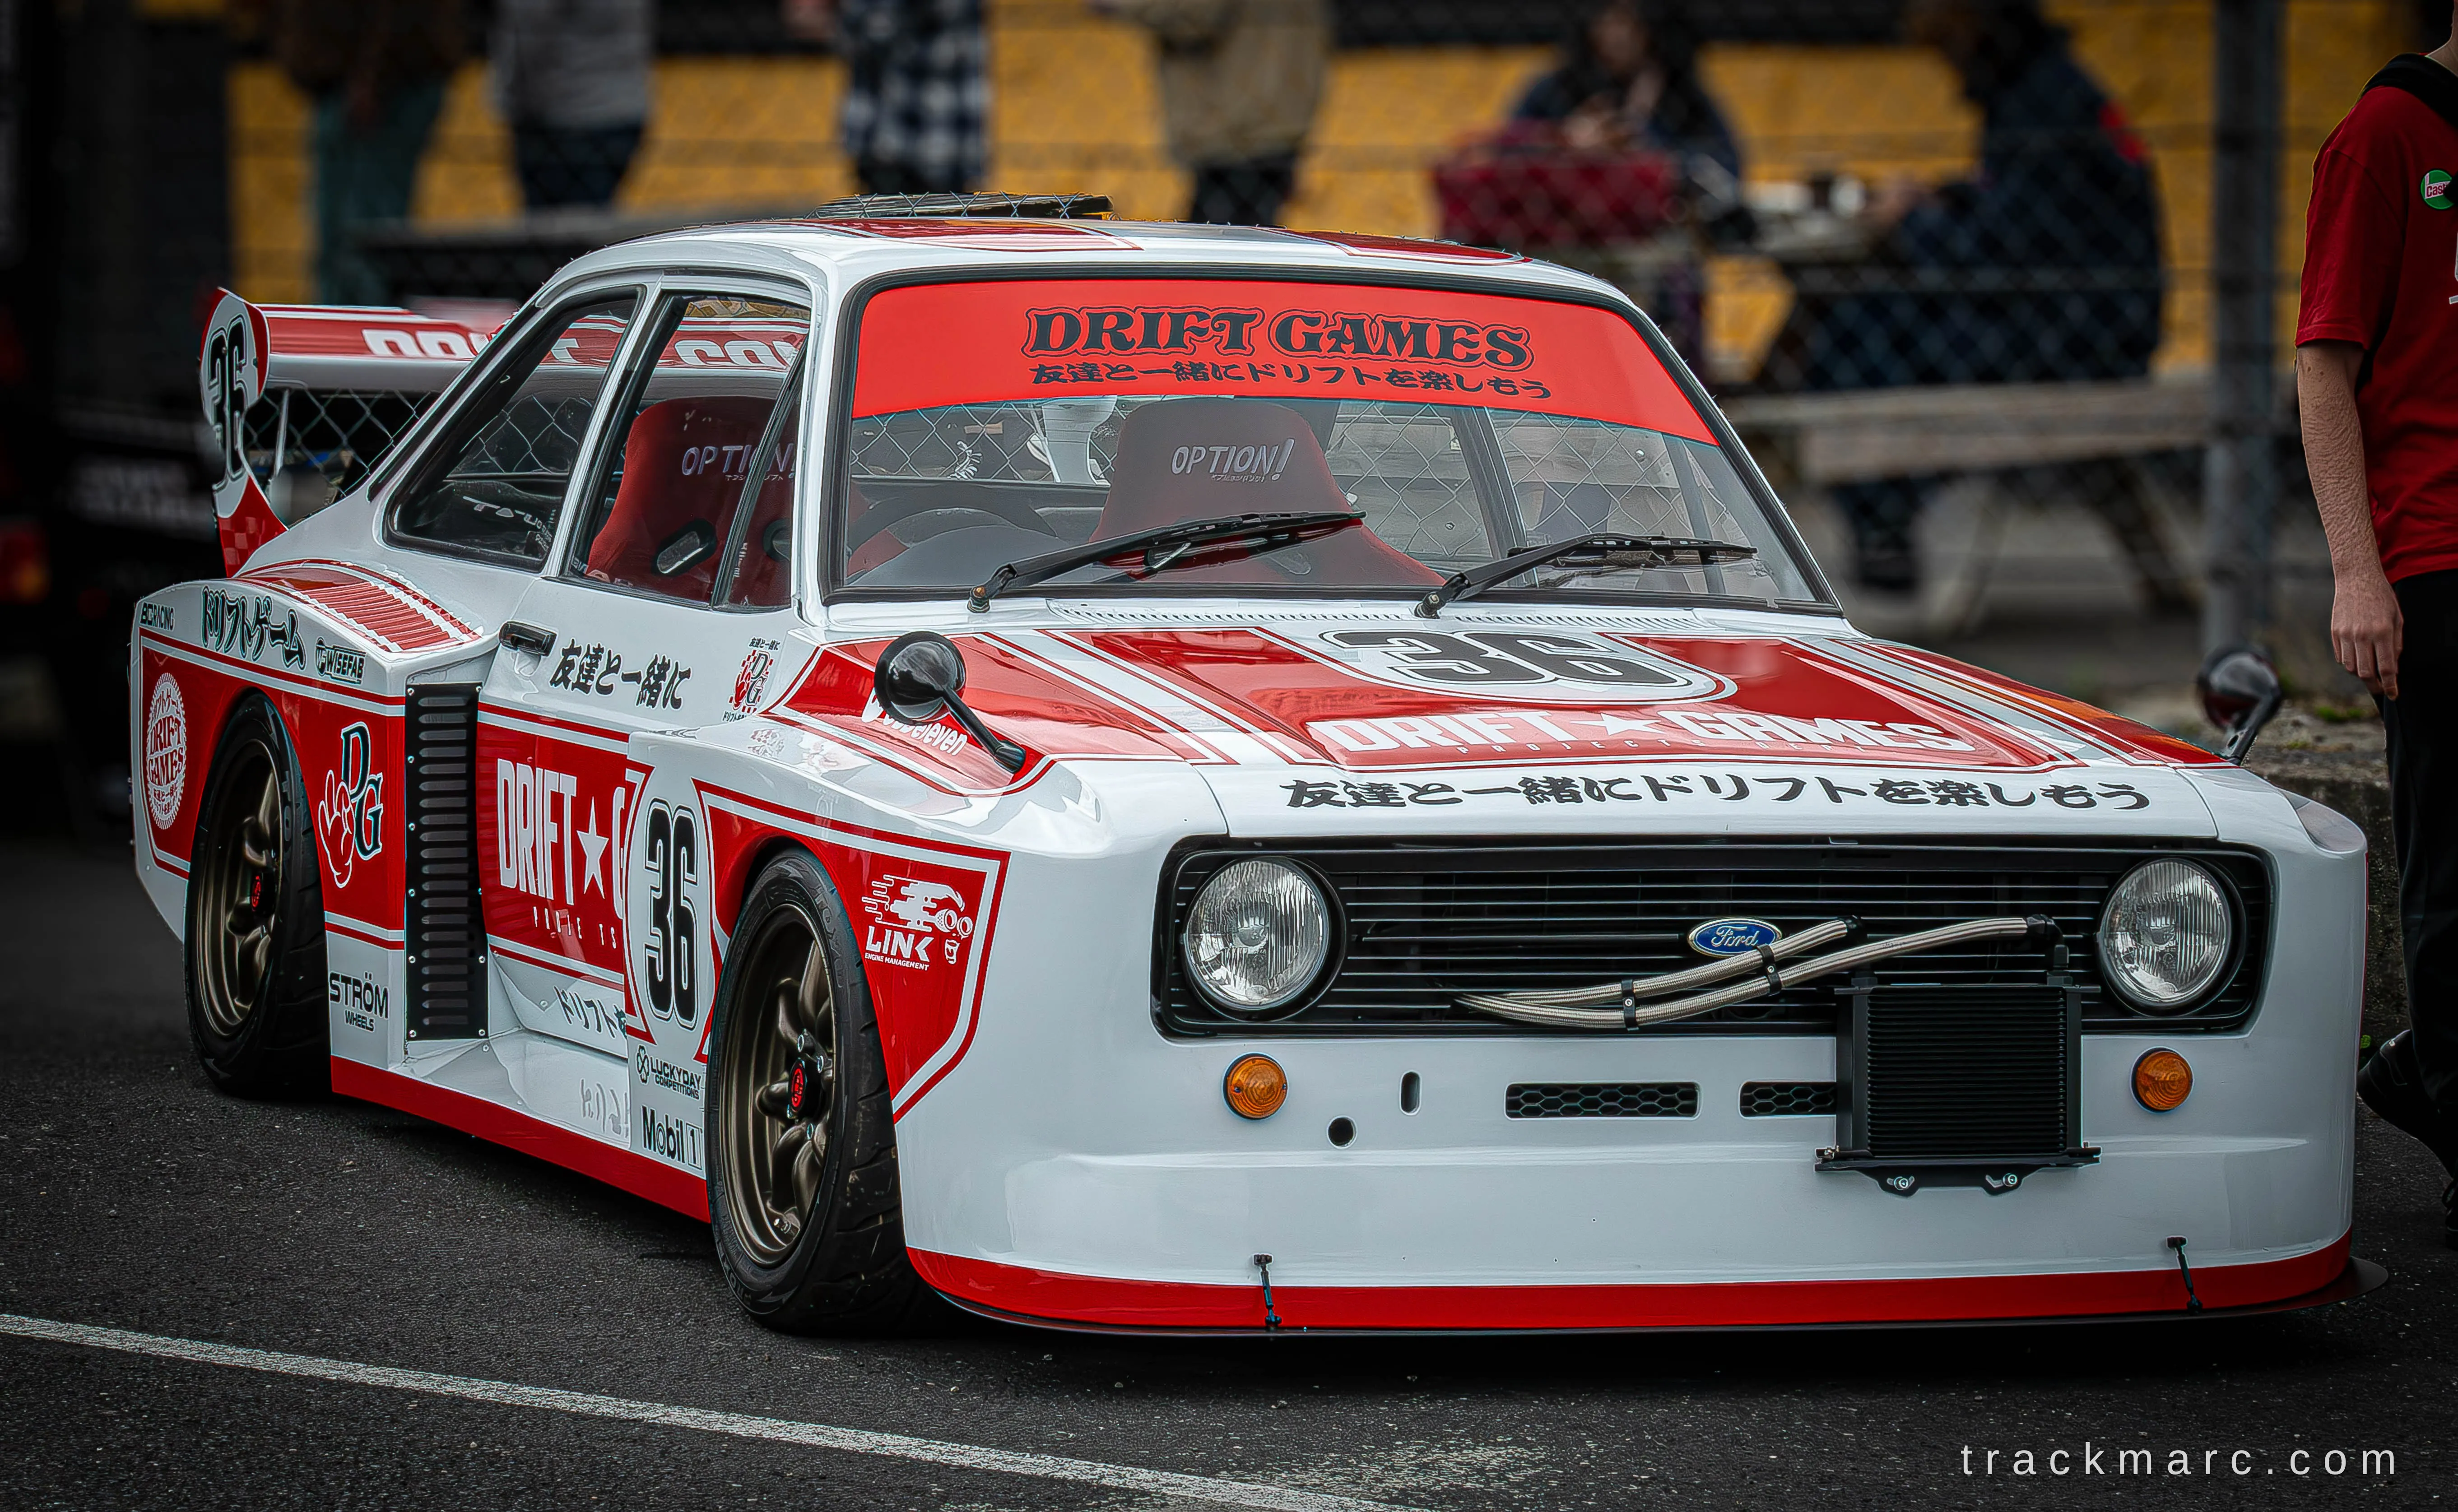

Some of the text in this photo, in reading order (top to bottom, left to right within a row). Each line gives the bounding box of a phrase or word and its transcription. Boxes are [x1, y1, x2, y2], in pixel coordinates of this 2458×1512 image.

[1023, 307, 1533, 371] DRIFT GAMES
[1030, 362, 1552, 399] 友達と一緒にドリフトを楽しもう
[1171, 438, 1295, 481] OPTION!
[202, 586, 306, 671] ドリフトゲーム
[326, 650, 365, 679] WISEFAB
[549, 638, 692, 710] 友達と一緒に
[1319, 630, 1692, 687] 36
[150, 716, 181, 755] DRIFT
[1305, 710, 1975, 752] DRIFT GAMES
[1457, 738, 1705, 754] PROJECTS
[149, 747, 184, 787] GAMES
[1279, 775, 2151, 811] 友達と一緒にドリフトを楽しもう
[497, 758, 577, 906] DRIFT
[644, 798, 699, 1031] 36
[866, 926, 934, 962] LINK
[1711, 926, 1759, 947] Ford
[864, 952, 929, 971] ENGINE MANAGEMENT
[329, 972, 389, 1019] STRÖM
[345, 1010, 374, 1032] WHEELS
[650, 1059, 702, 1090] LUCKYDAY
[655, 1074, 700, 1100] COMPETITIONS
[641, 1105, 685, 1164] Mobil
